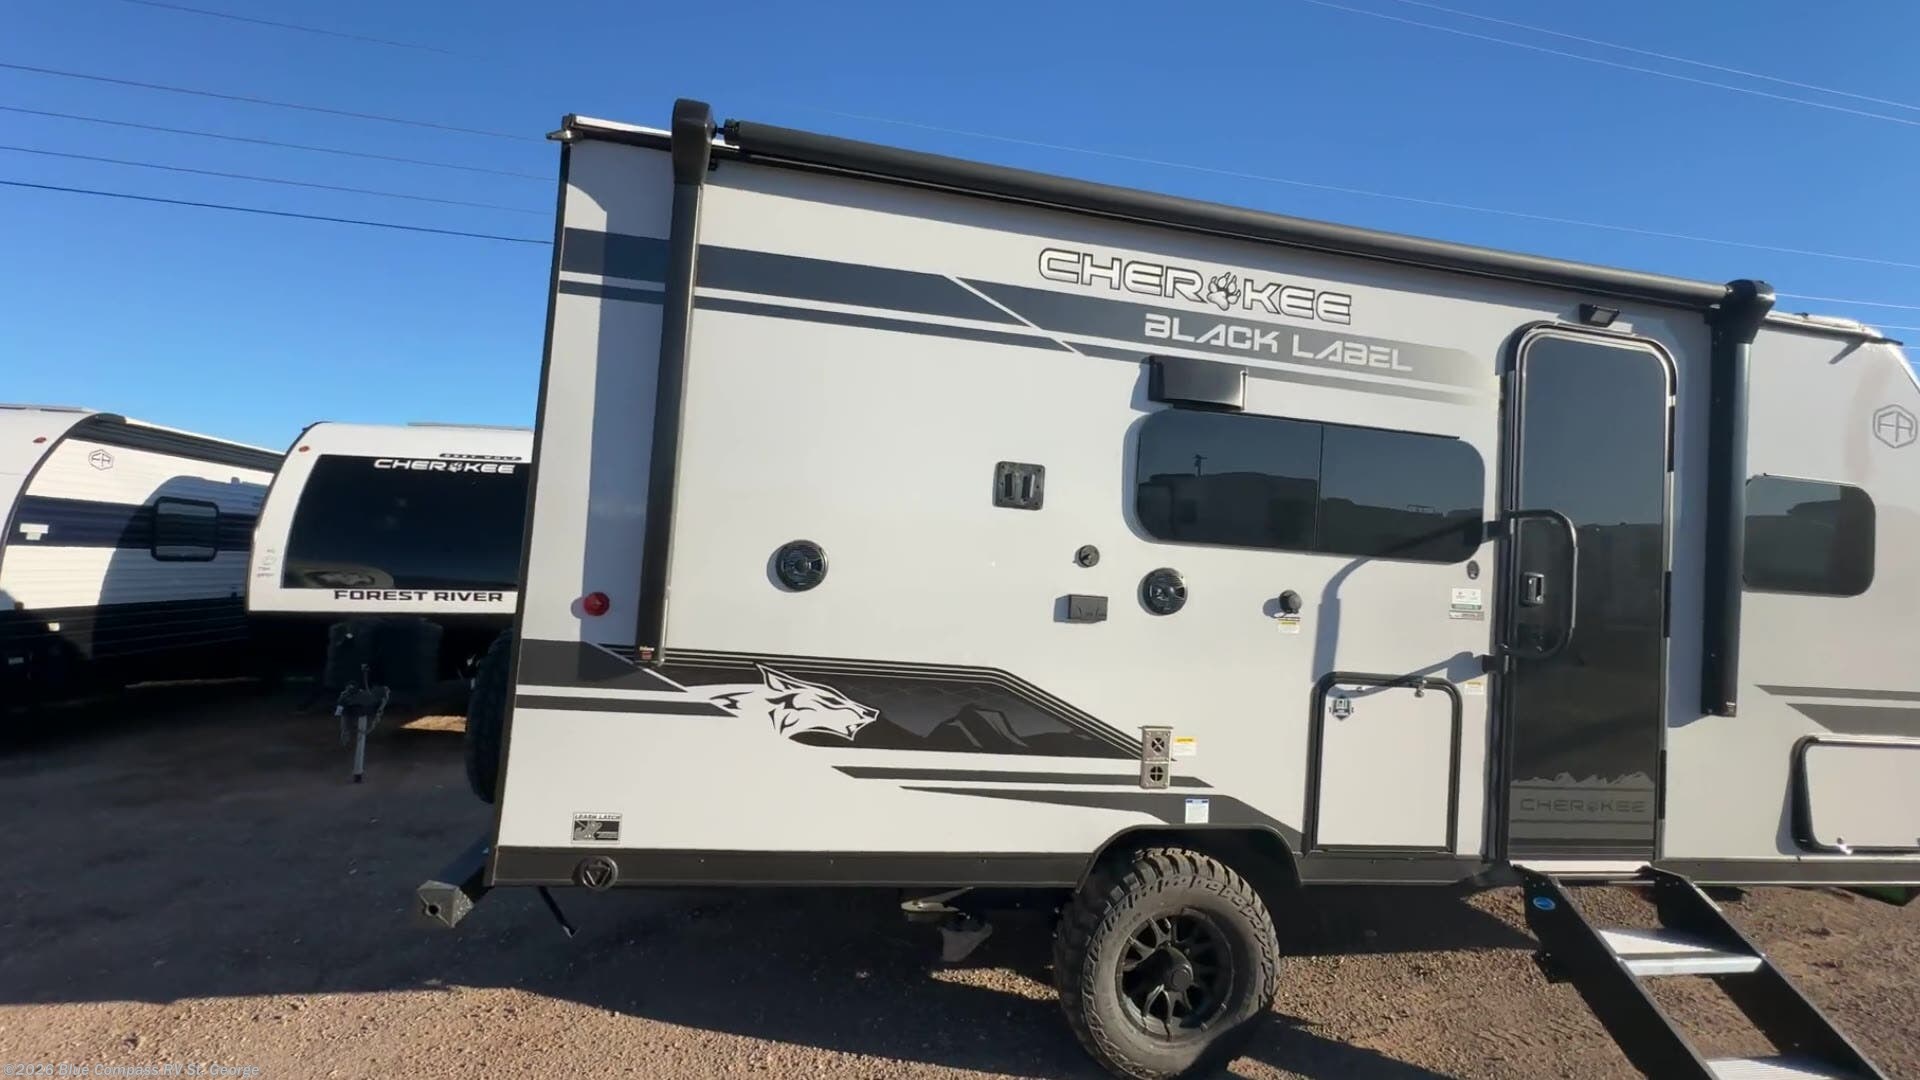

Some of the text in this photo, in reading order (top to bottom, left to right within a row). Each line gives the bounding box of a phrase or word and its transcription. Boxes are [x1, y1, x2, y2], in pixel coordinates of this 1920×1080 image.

[1144, 313, 1414, 373] BLACK LABEL
[333, 589, 504, 602] FOREST RIVER
